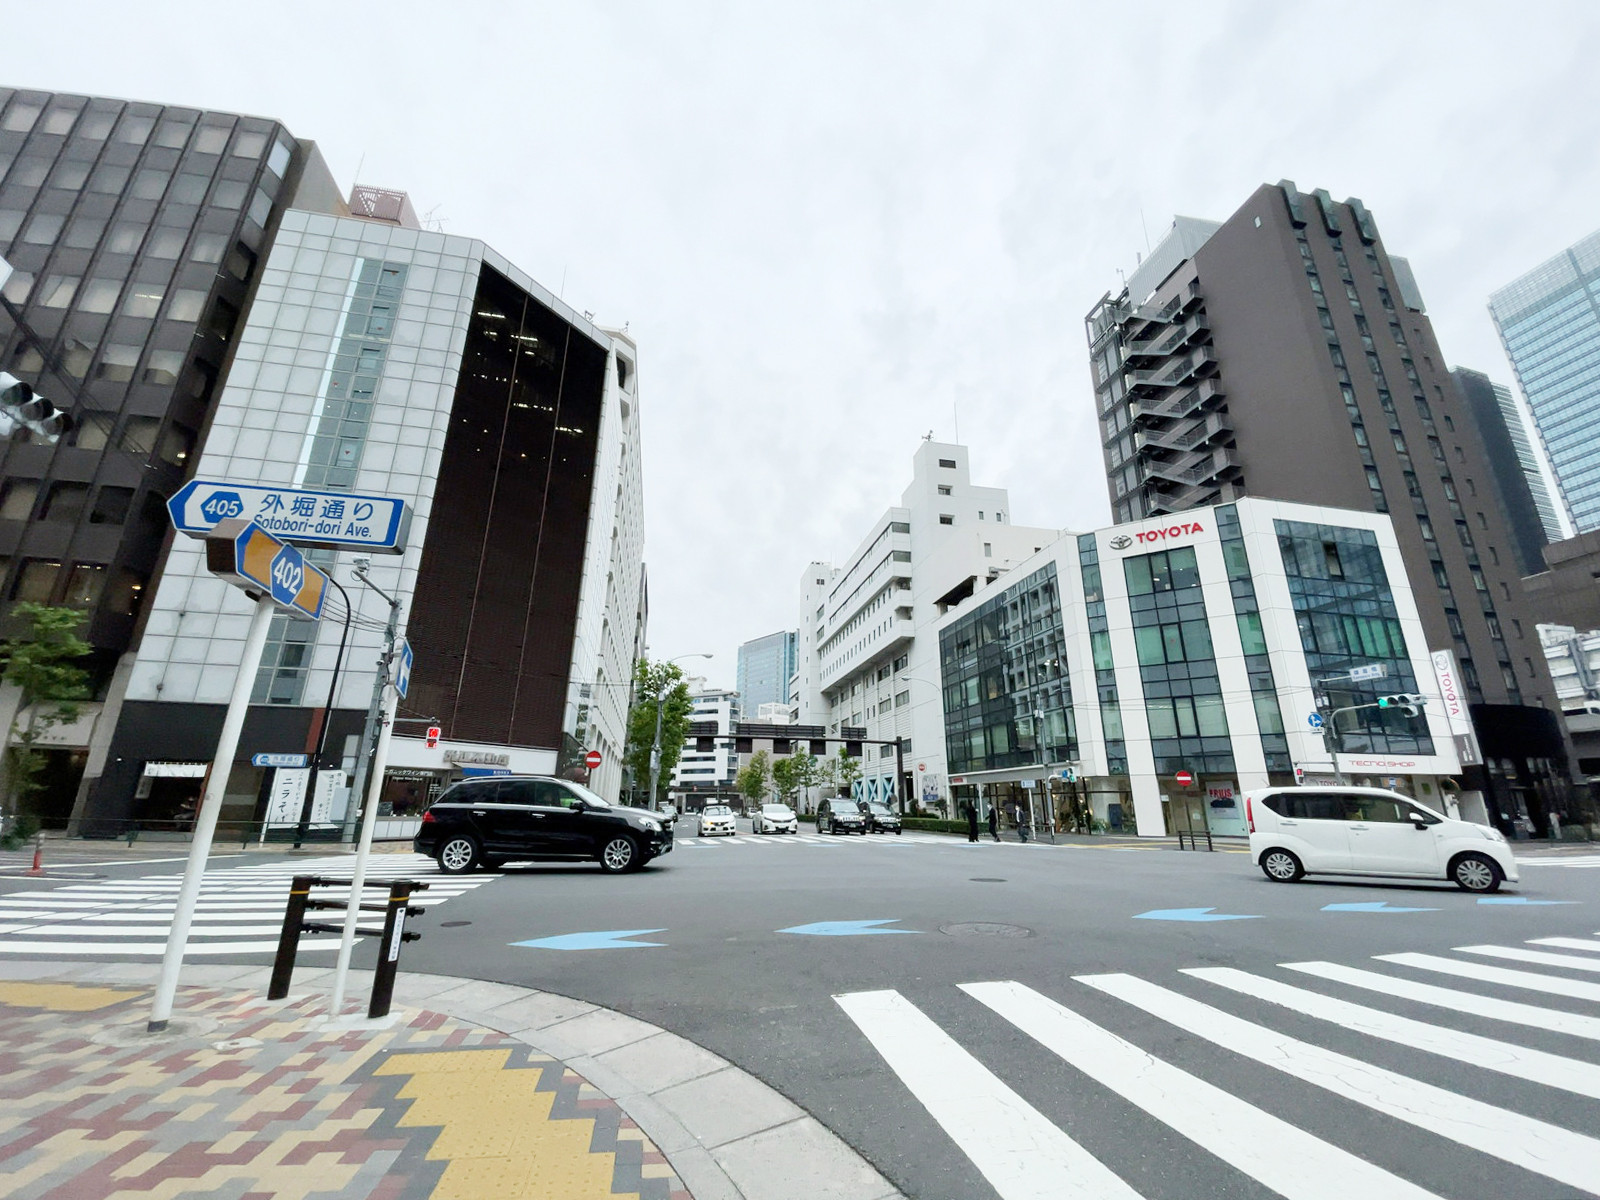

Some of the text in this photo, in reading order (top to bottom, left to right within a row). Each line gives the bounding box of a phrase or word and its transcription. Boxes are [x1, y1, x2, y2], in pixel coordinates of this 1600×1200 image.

[205, 500, 239, 516] 405
[260, 494, 374, 521] 外堀通り
[253, 514, 372, 538] Sotobori-dori Ave.
[1136, 522, 1204, 543] TOYOTA
[273, 557, 302, 595] 402
[1441, 672, 1460, 715] TOYOTA
